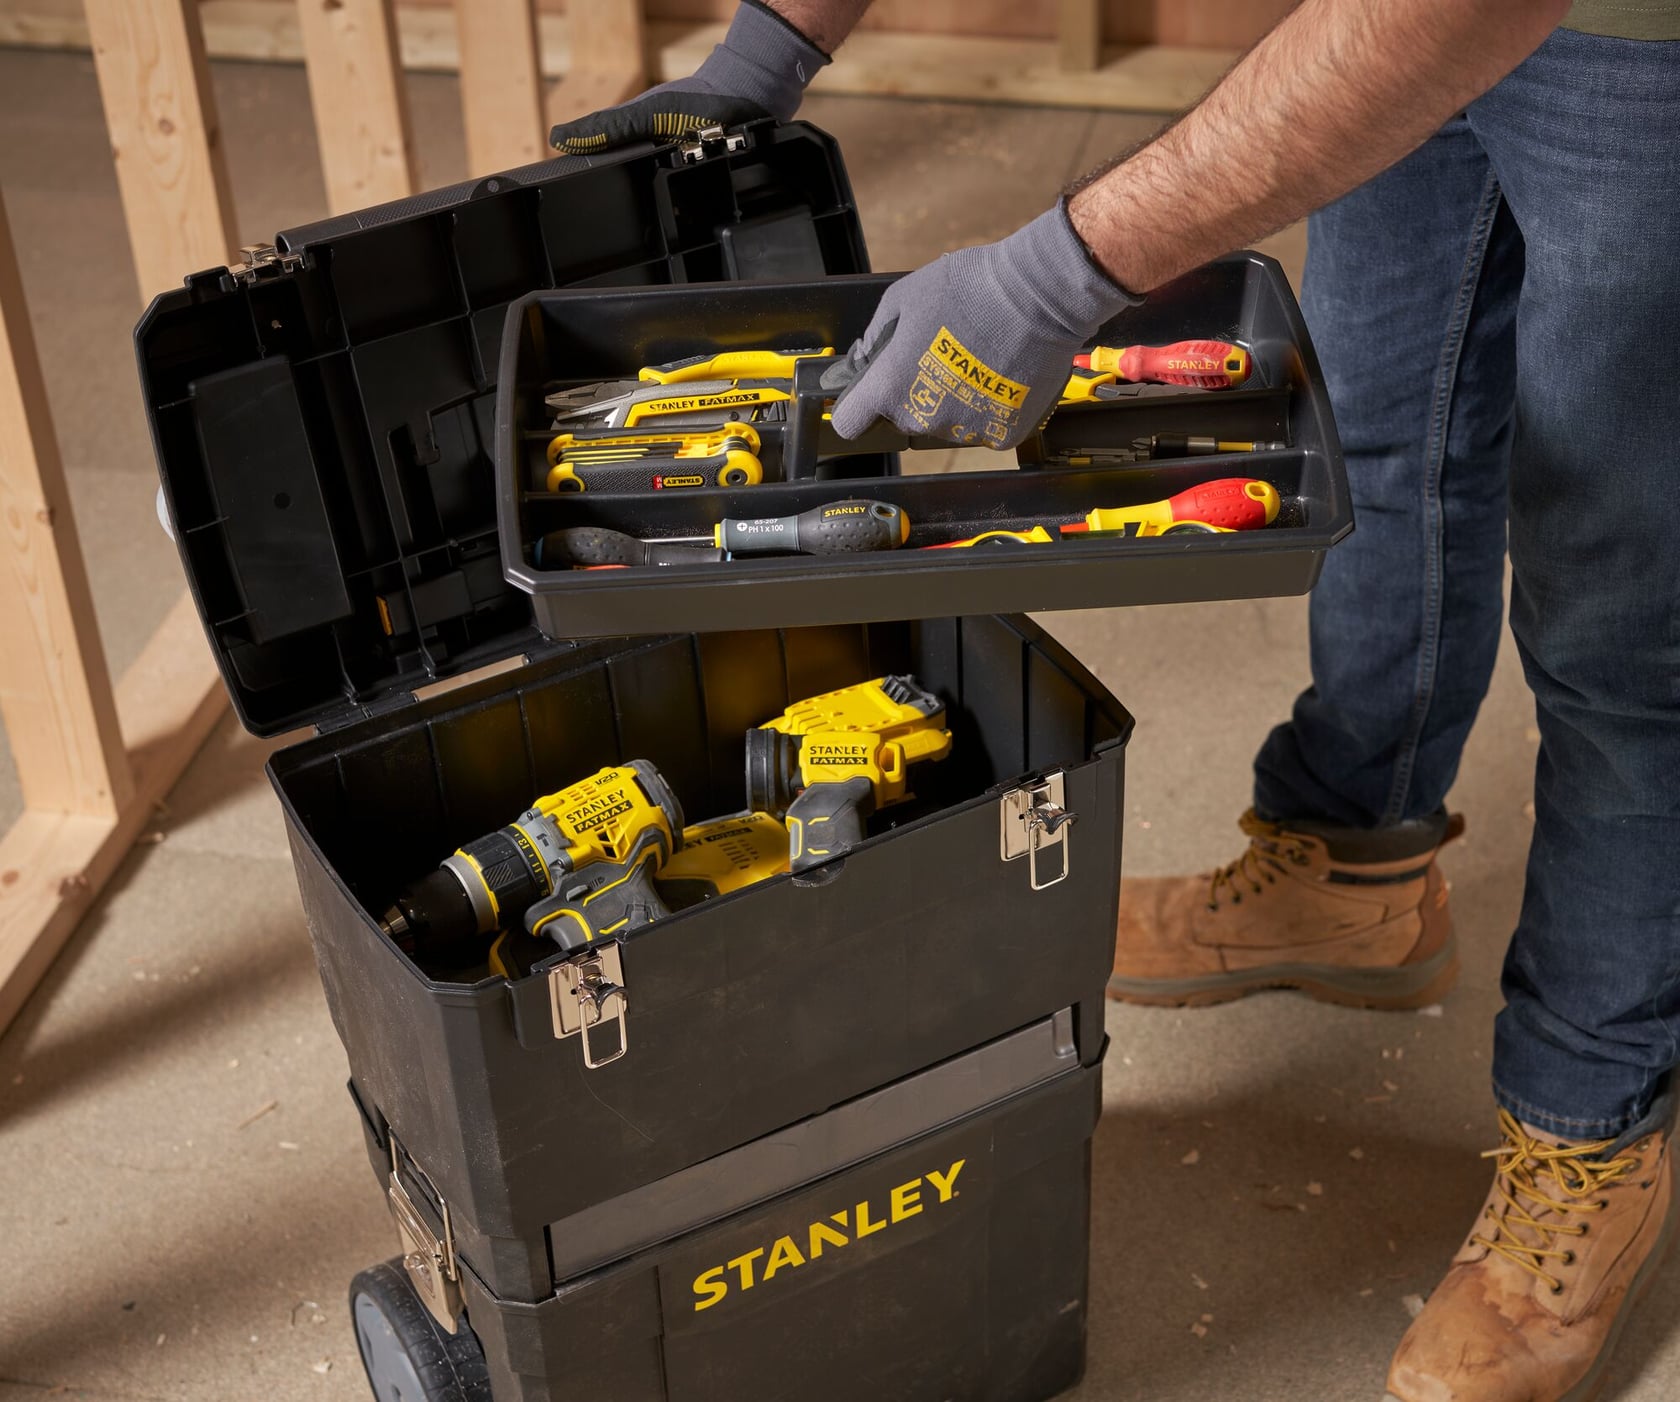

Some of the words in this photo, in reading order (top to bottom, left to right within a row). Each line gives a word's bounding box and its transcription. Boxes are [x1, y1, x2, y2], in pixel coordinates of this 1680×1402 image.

[936, 337, 1021, 402] STANLEY
[1167, 359, 1220, 370] STANLEY
[649, 400, 695, 412] STANLEY
[704, 394, 755, 406] FATMAX
[666, 477, 701, 485] STANLEY
[824, 506, 866, 518] STANLEY
[748, 526, 759, 534] PH
[771, 524, 784, 532] 100
[809, 745, 868, 755] STANLEY
[565, 789, 626, 823] STANLEY
[576, 802, 630, 832] FATMAX
[692, 1159, 966, 1311] STANLEY
